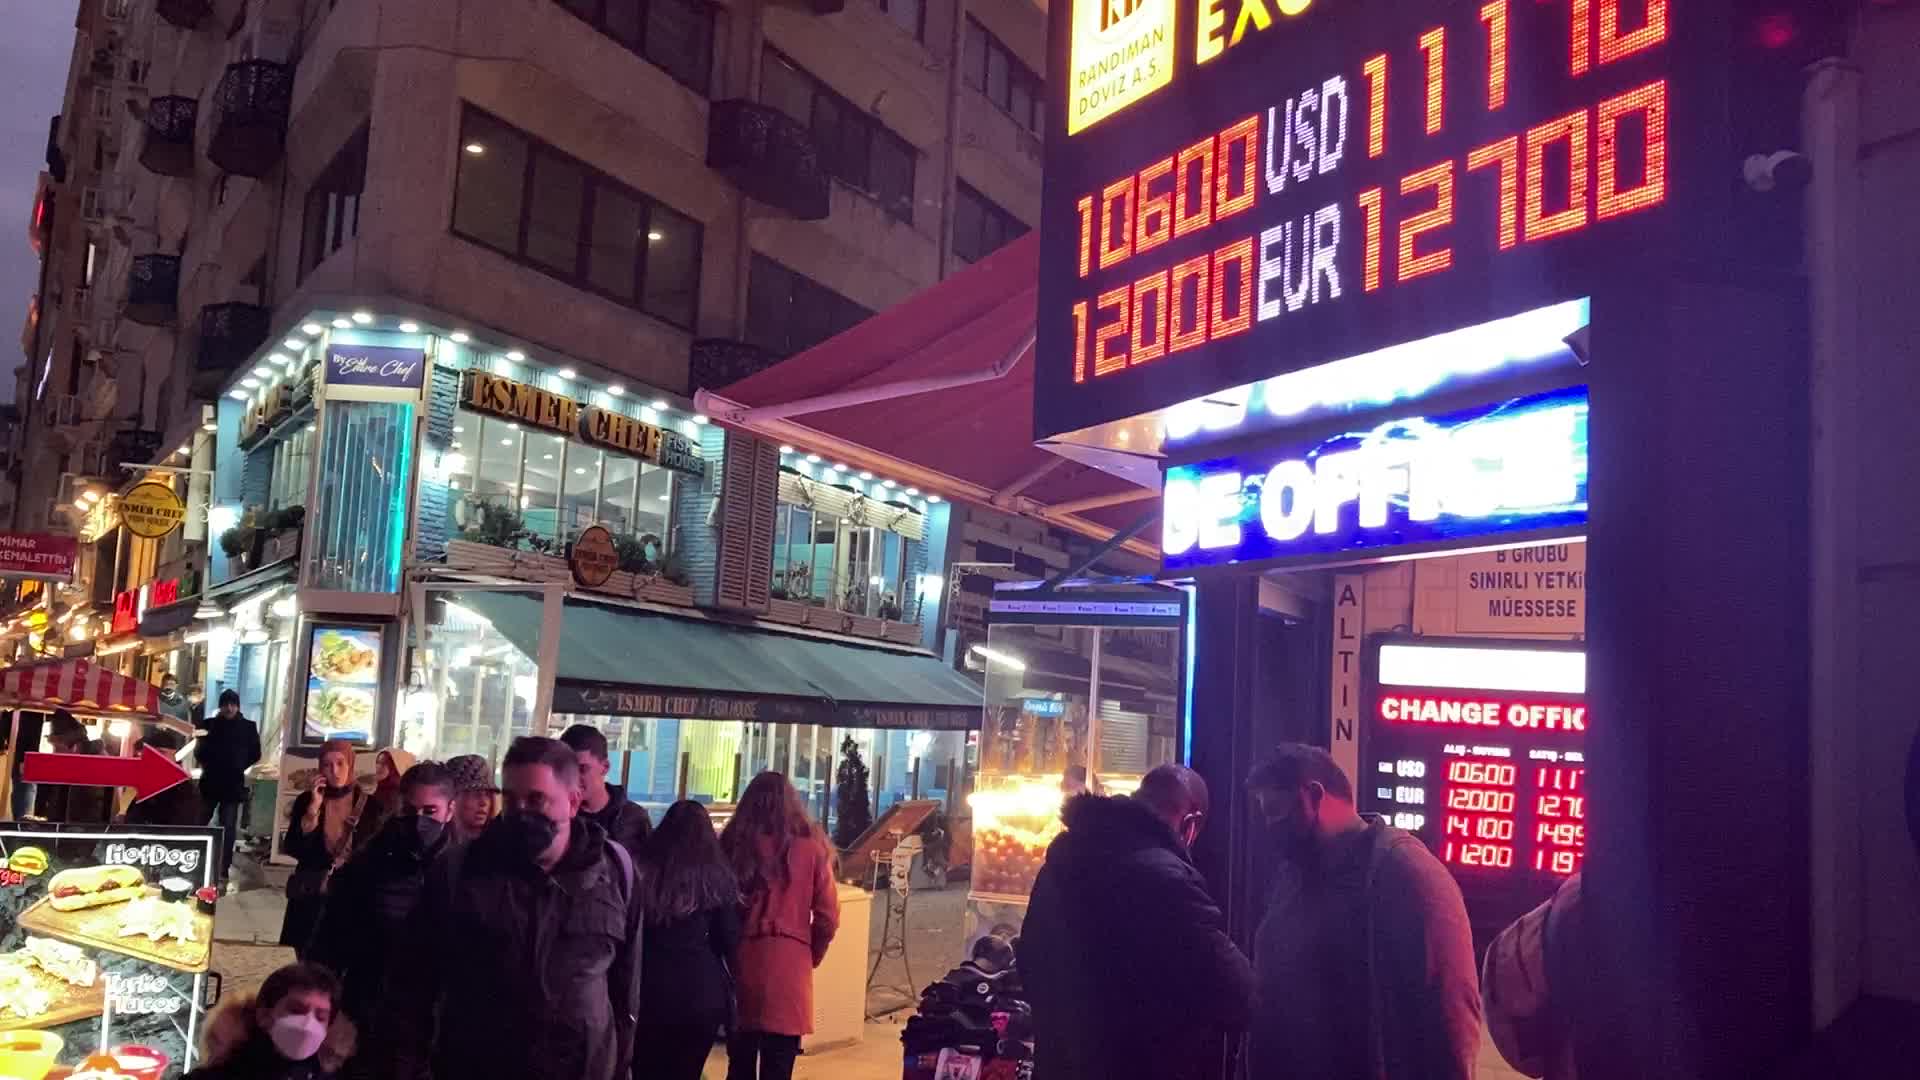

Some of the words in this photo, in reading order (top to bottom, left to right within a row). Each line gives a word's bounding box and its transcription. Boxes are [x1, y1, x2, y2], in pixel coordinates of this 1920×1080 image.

[1197, 0, 1315, 64] EX
[1079, 24, 1164, 88] RANDIMAN
[1077, 115, 1259, 278] 10600
[1265, 75, 1348, 195] USD
[1072, 235, 1254, 383] 12000
[1257, 202, 1342, 322] EUR
[1359, 79, 1667, 293] 12700
[380, 360, 416, 383] Chef
[472, 372, 580, 434] ESMER
[582, 405, 664, 463] CHEF
[1488, 596, 1577, 617] MÜESSESE
[1335, 584, 1357, 741] ALTIN
[616, 693, 662, 714] ESMER
[1381, 698, 1501, 725] CHANGE
[1397, 760, 1425, 777] USD
[1396, 787, 1424, 804] EUR
